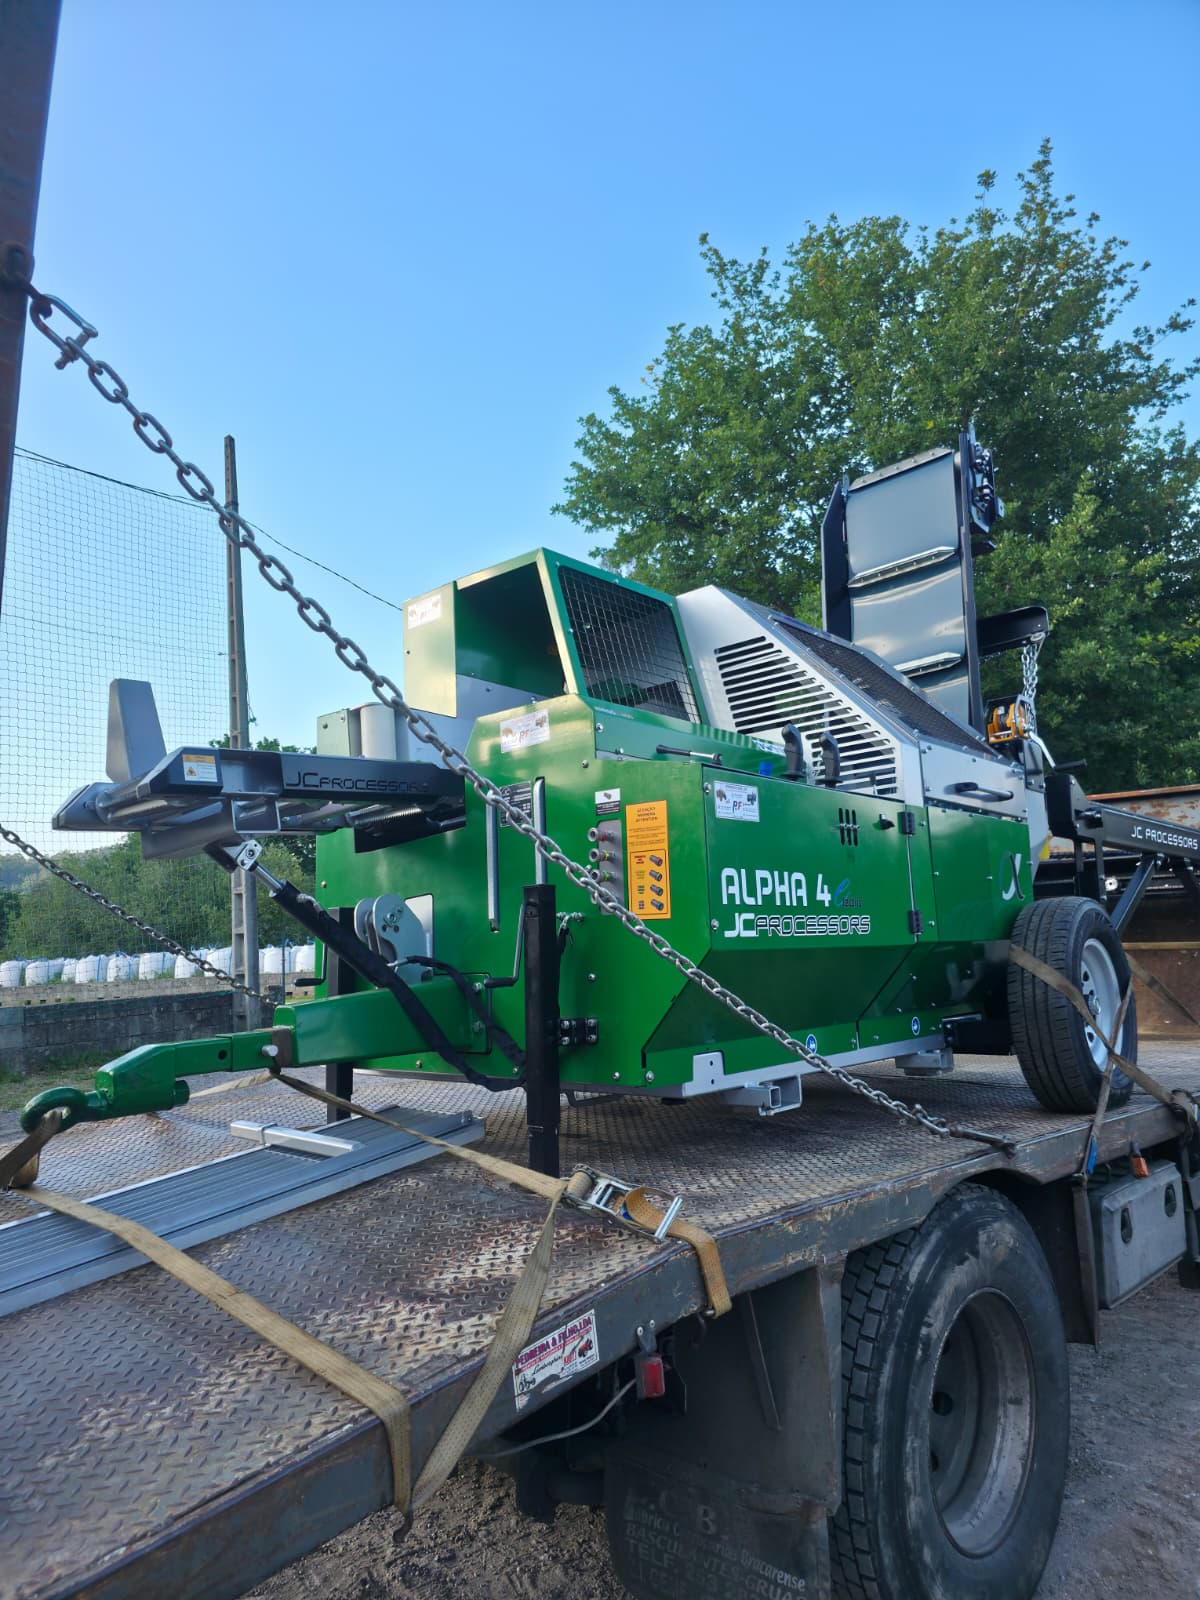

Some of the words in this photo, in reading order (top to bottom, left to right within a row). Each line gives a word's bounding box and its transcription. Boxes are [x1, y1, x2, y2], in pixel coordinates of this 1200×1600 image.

[1131, 826, 1143, 839] JC
[1145, 828, 1198, 850] PROCESSORS
[721, 867, 807, 907] ALPHA
[816, 873, 831, 907] 4
